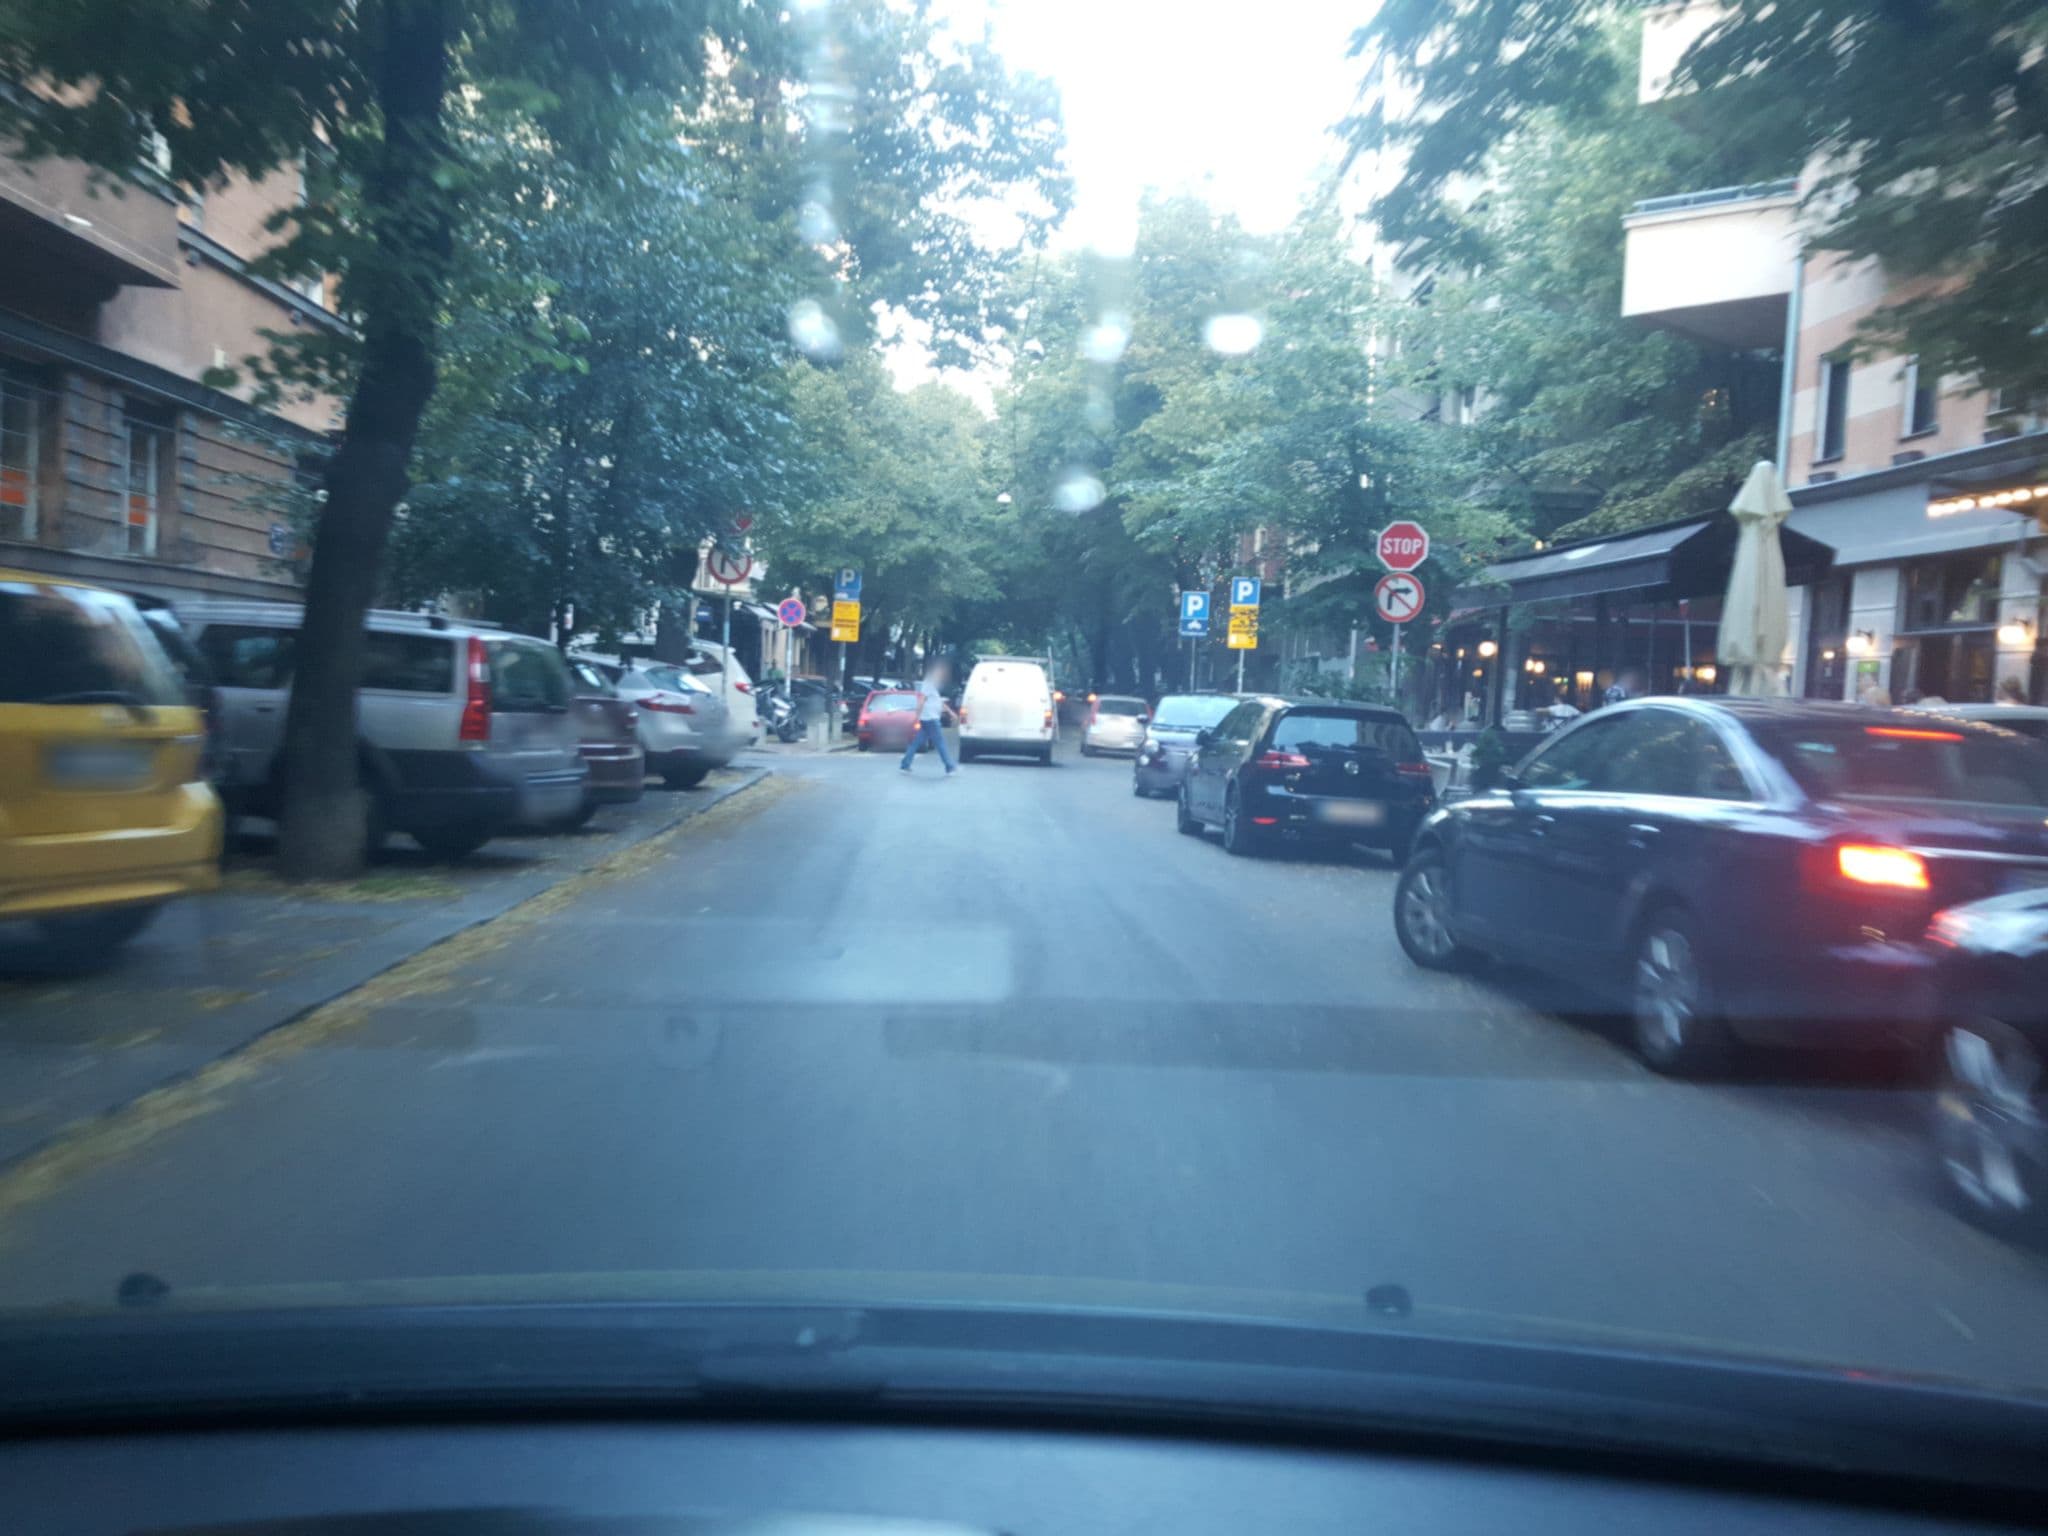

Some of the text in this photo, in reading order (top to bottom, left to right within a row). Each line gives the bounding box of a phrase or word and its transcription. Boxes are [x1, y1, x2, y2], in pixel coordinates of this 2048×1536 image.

[1382, 537, 1422, 555] STOP
[841, 568, 855, 587] P
[1236, 580, 1254, 602] P
[1186, 594, 1204, 617] P
